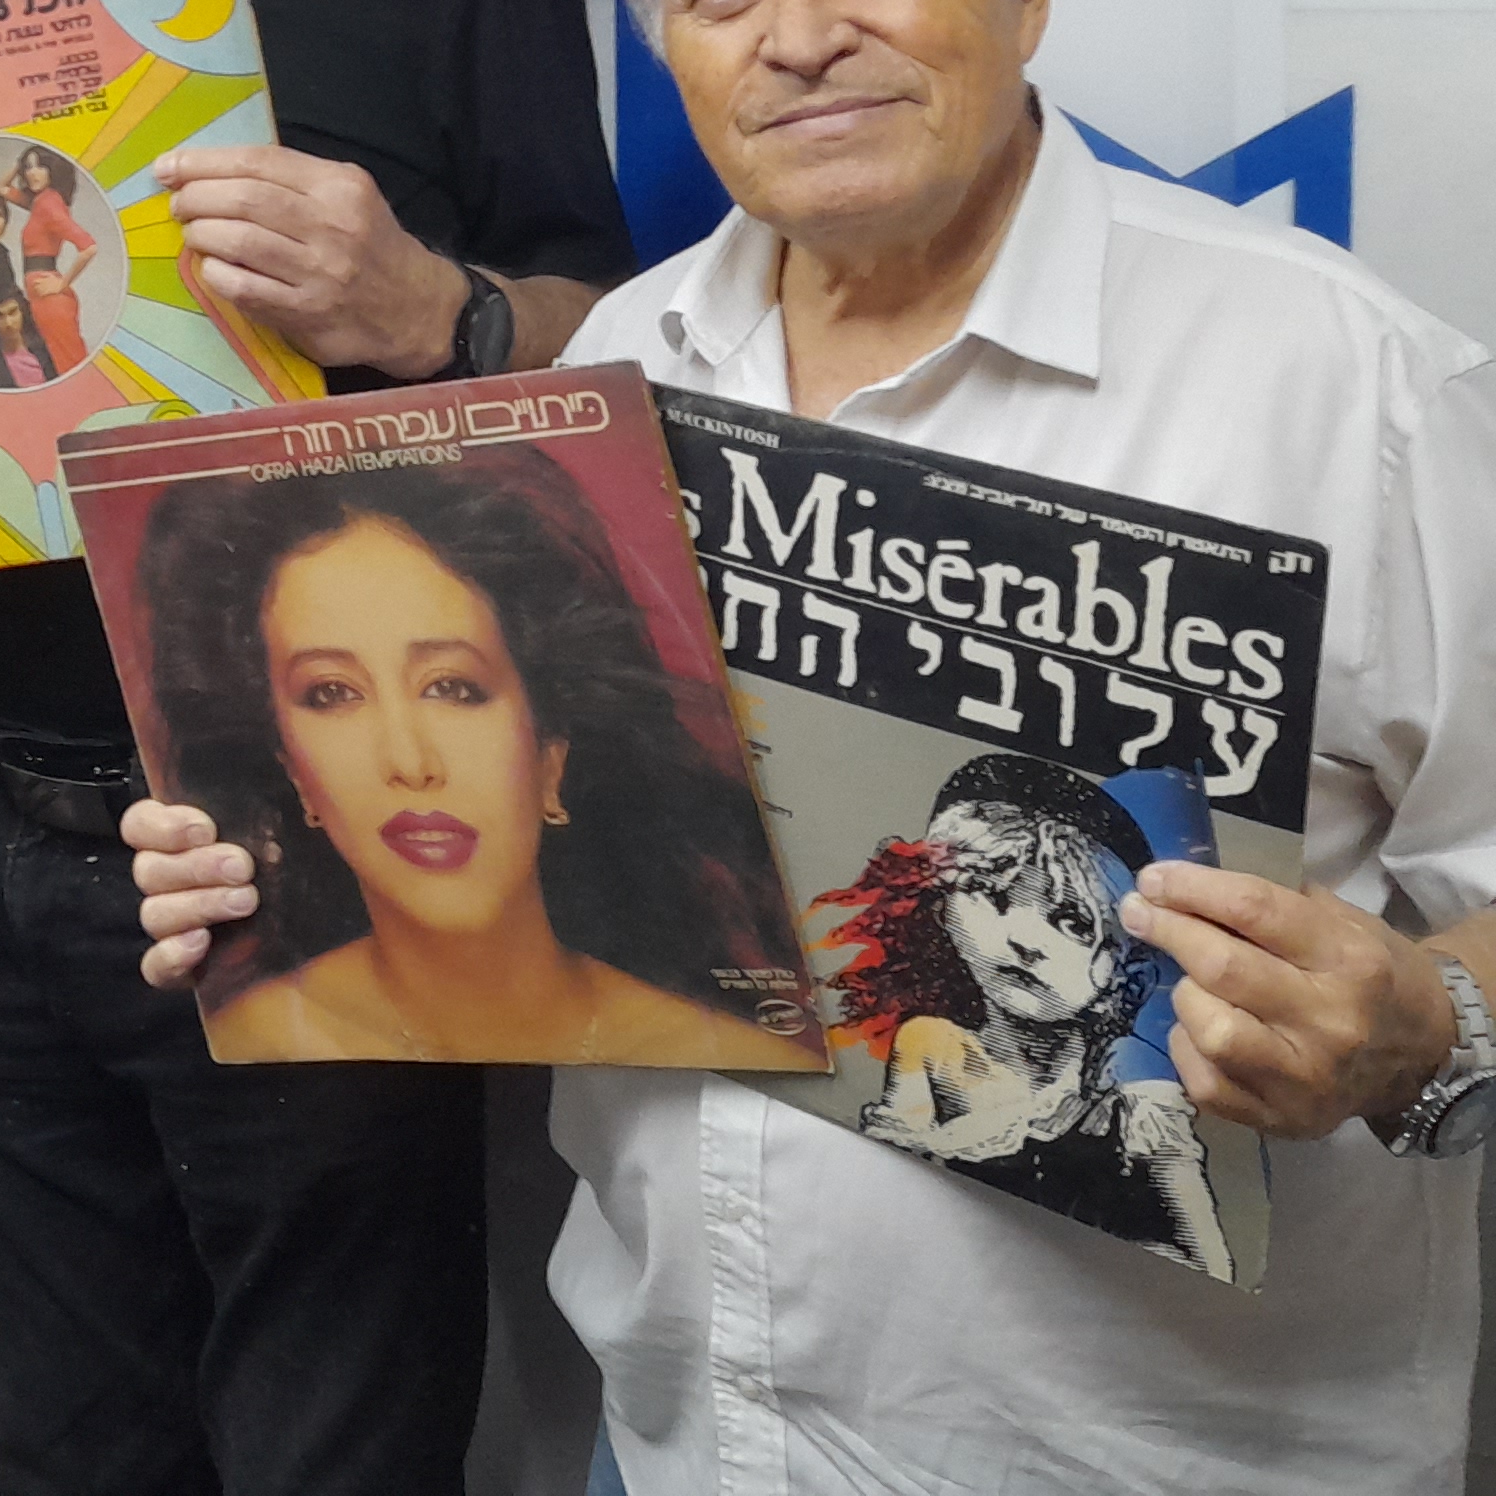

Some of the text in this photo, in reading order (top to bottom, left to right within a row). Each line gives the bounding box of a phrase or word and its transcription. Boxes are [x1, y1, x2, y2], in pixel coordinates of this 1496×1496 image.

[249, 460, 299, 484] OFRA
[301, 455, 347, 478] HAZA
[906, 619, 1281, 798] עלובי
